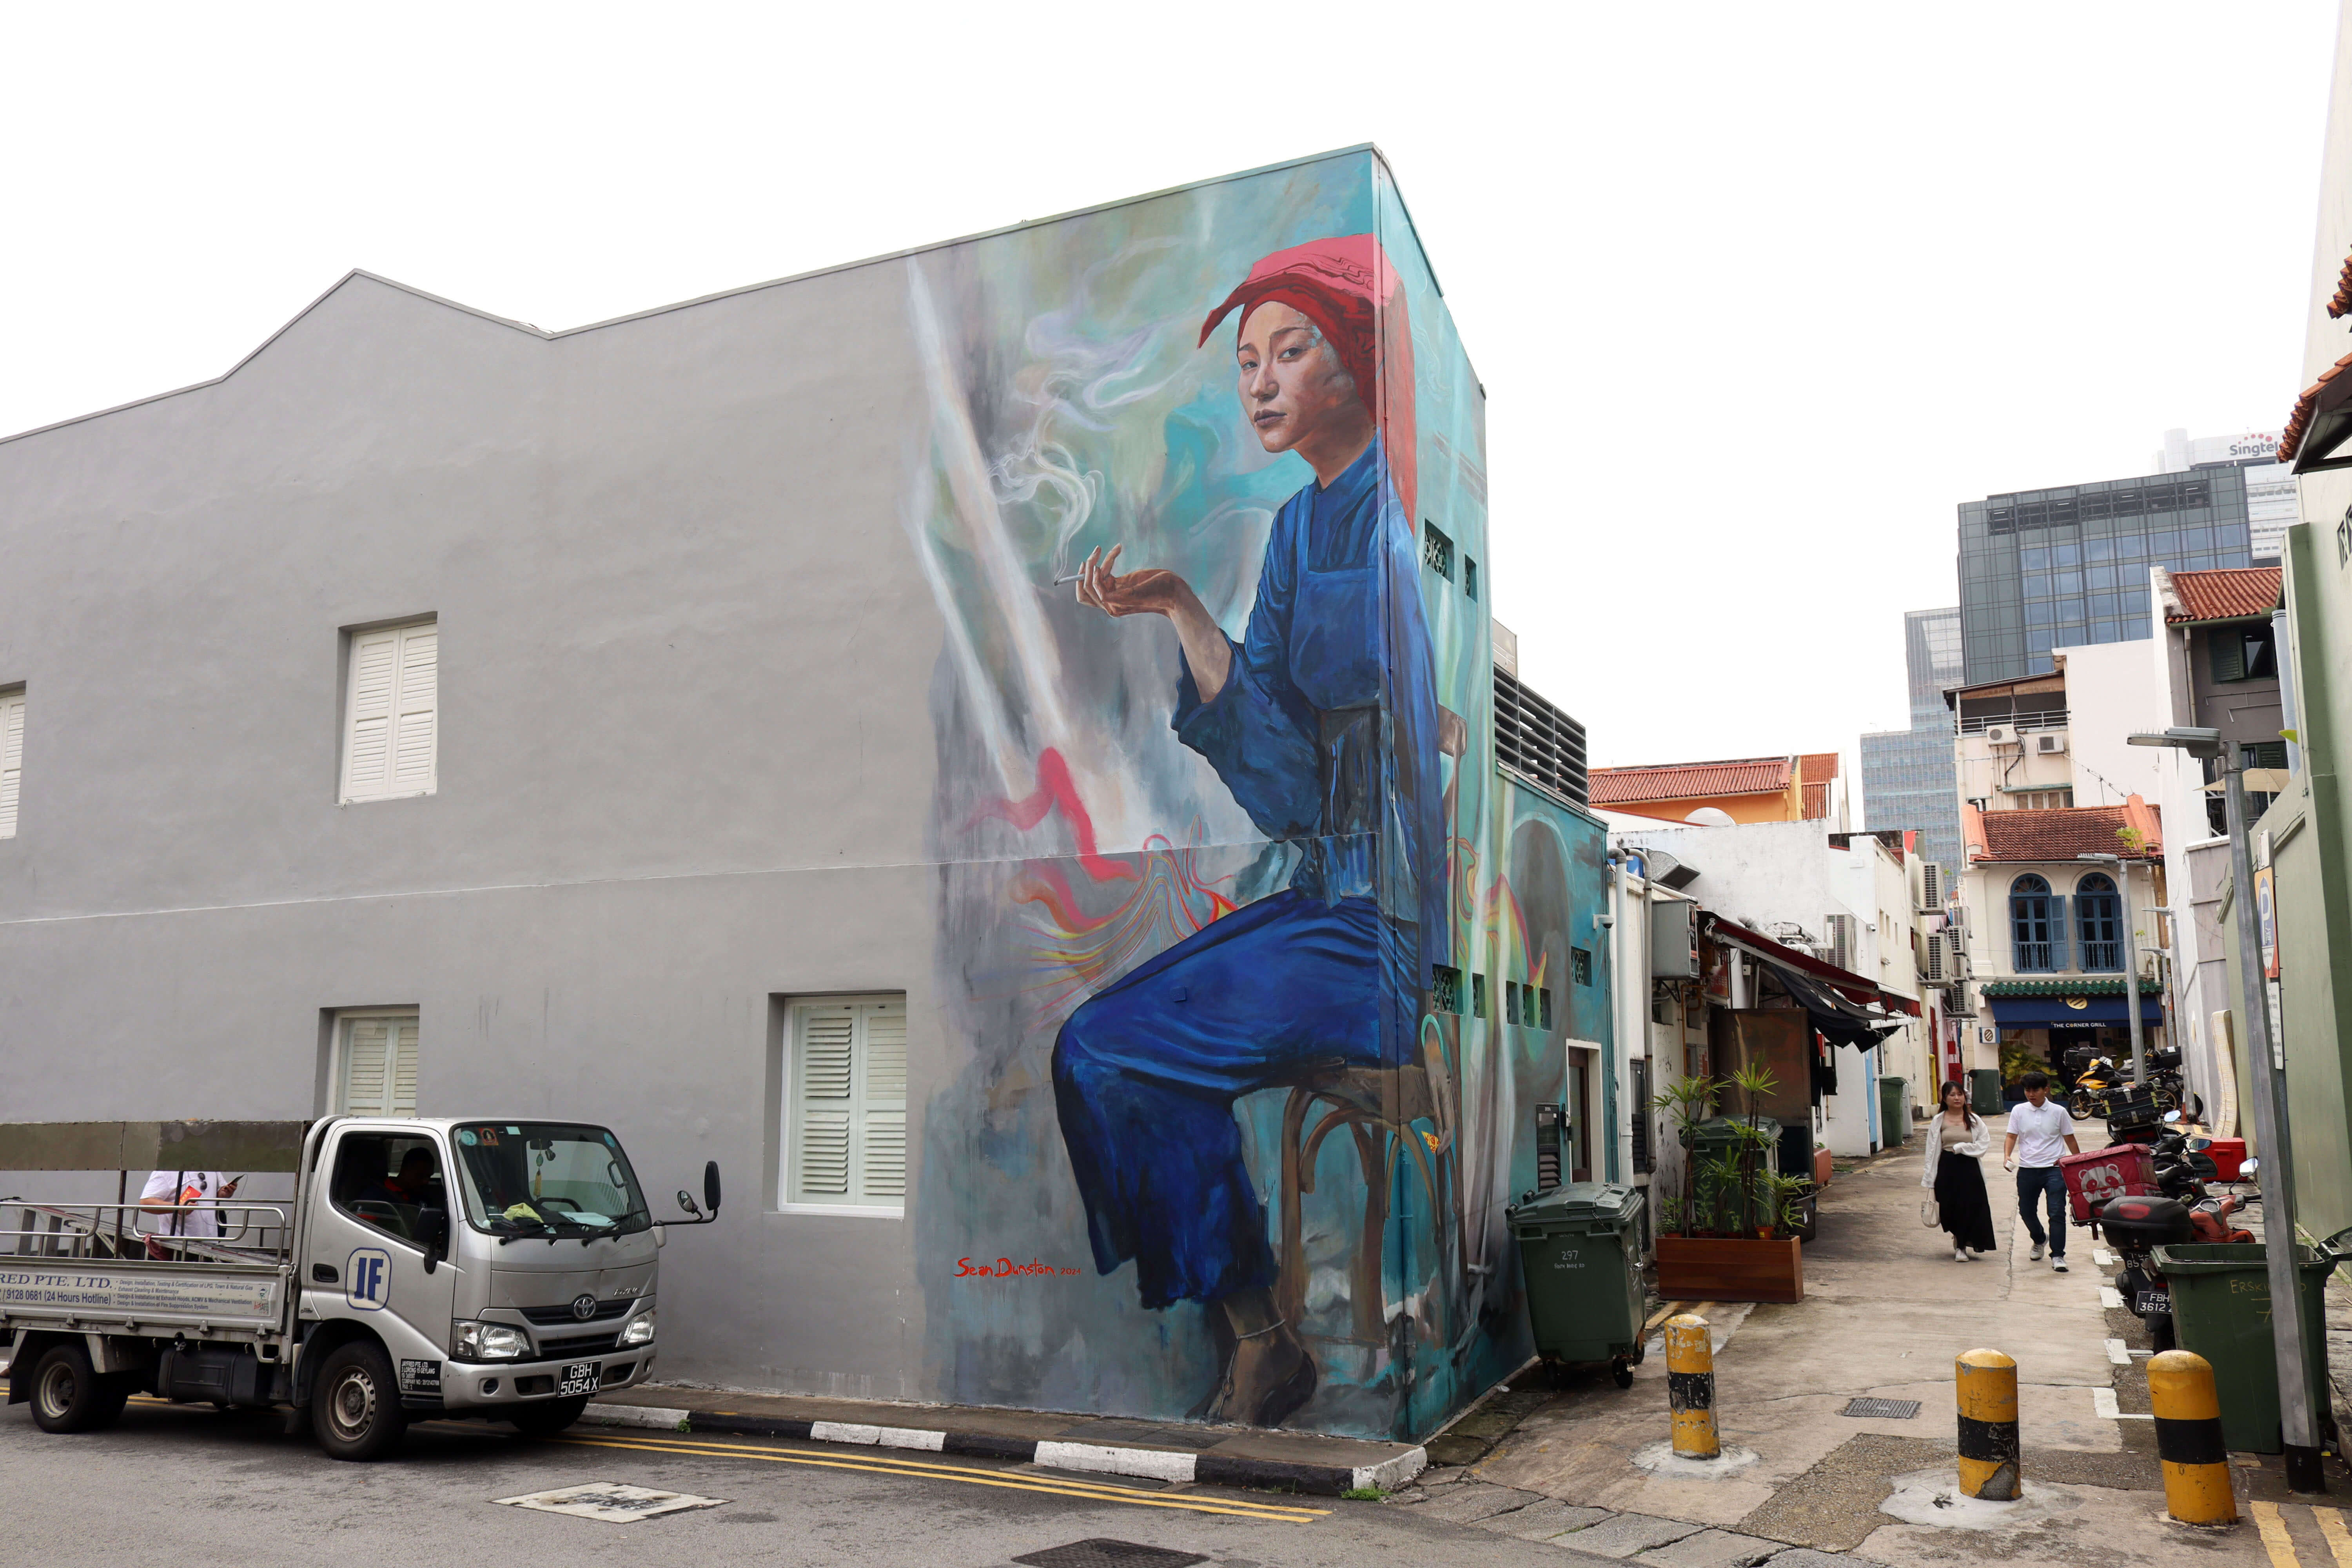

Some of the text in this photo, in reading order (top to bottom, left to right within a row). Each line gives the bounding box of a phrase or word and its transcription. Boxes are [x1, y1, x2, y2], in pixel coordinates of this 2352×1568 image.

[2229, 441, 2278, 457] Singtel
[1561, 1250, 1578, 1260] 297
[953, 1257, 994, 1278] Sean
[995, 1257, 1056, 1279] Dunston
[34, 1276, 70, 1287] PTE.
[75, 1277, 113, 1289] LTD.
[2230, 1279, 2271, 1294] ERSKI
[7, 1289, 24, 1299] 9128
[25, 1290, 42, 1301] 0681
[44, 1290, 55, 1302] (24
[57, 1292, 80, 1303] Hours
[82, 1292, 111, 1305] Hotline)
[2150, 1293, 2170, 1303] FBH
[570, 1363, 593, 1379] GBH
[560, 1376, 599, 1395] 5054X
